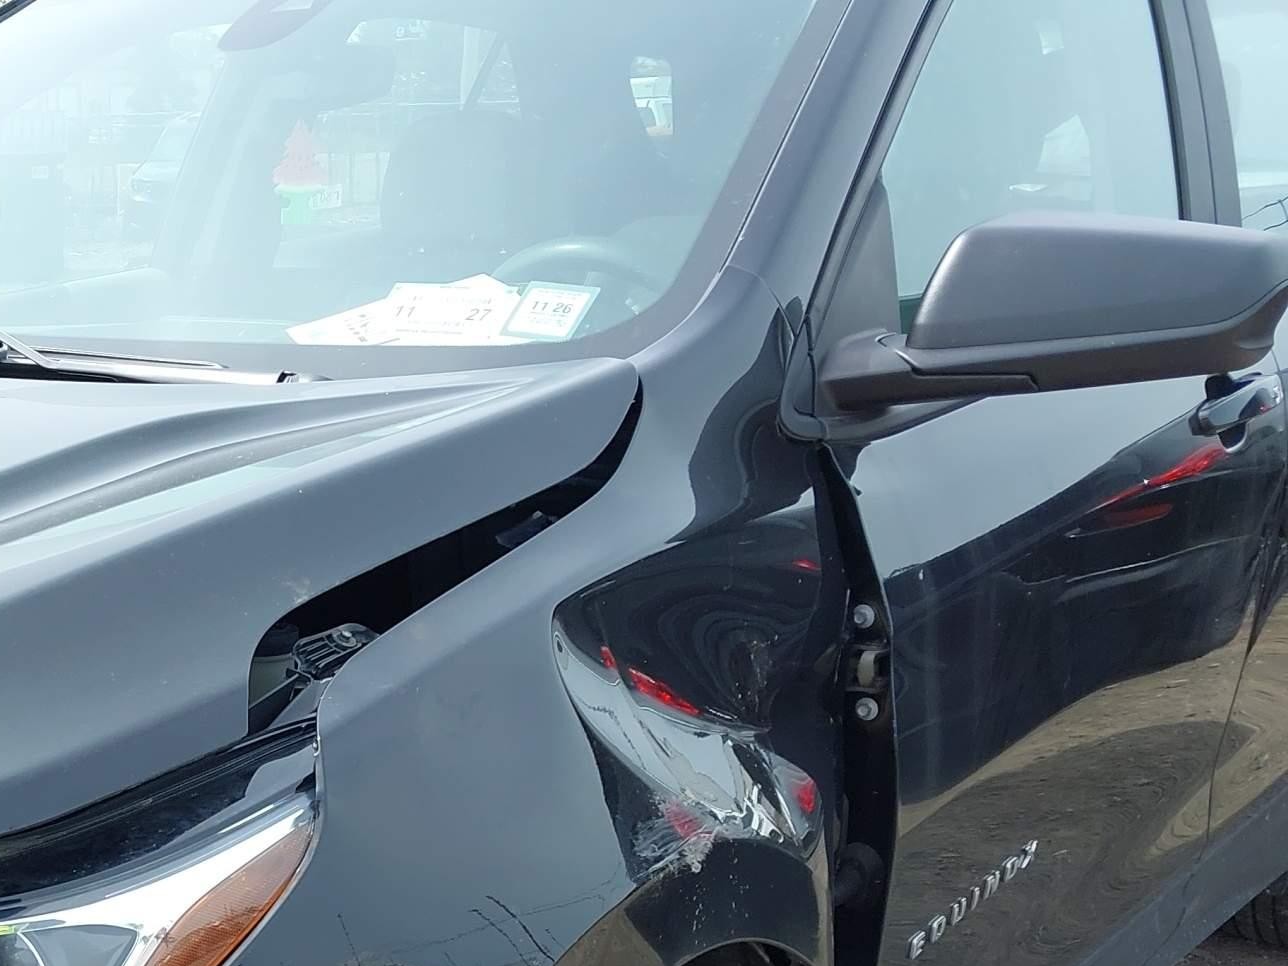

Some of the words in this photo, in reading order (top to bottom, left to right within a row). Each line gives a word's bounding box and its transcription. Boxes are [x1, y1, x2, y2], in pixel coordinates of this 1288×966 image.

[532, 301, 549, 312] 11
[552, 302, 573, 314] 26
[465, 308, 492, 321] 27
[906, 839, 1039, 961] EQUINOX
